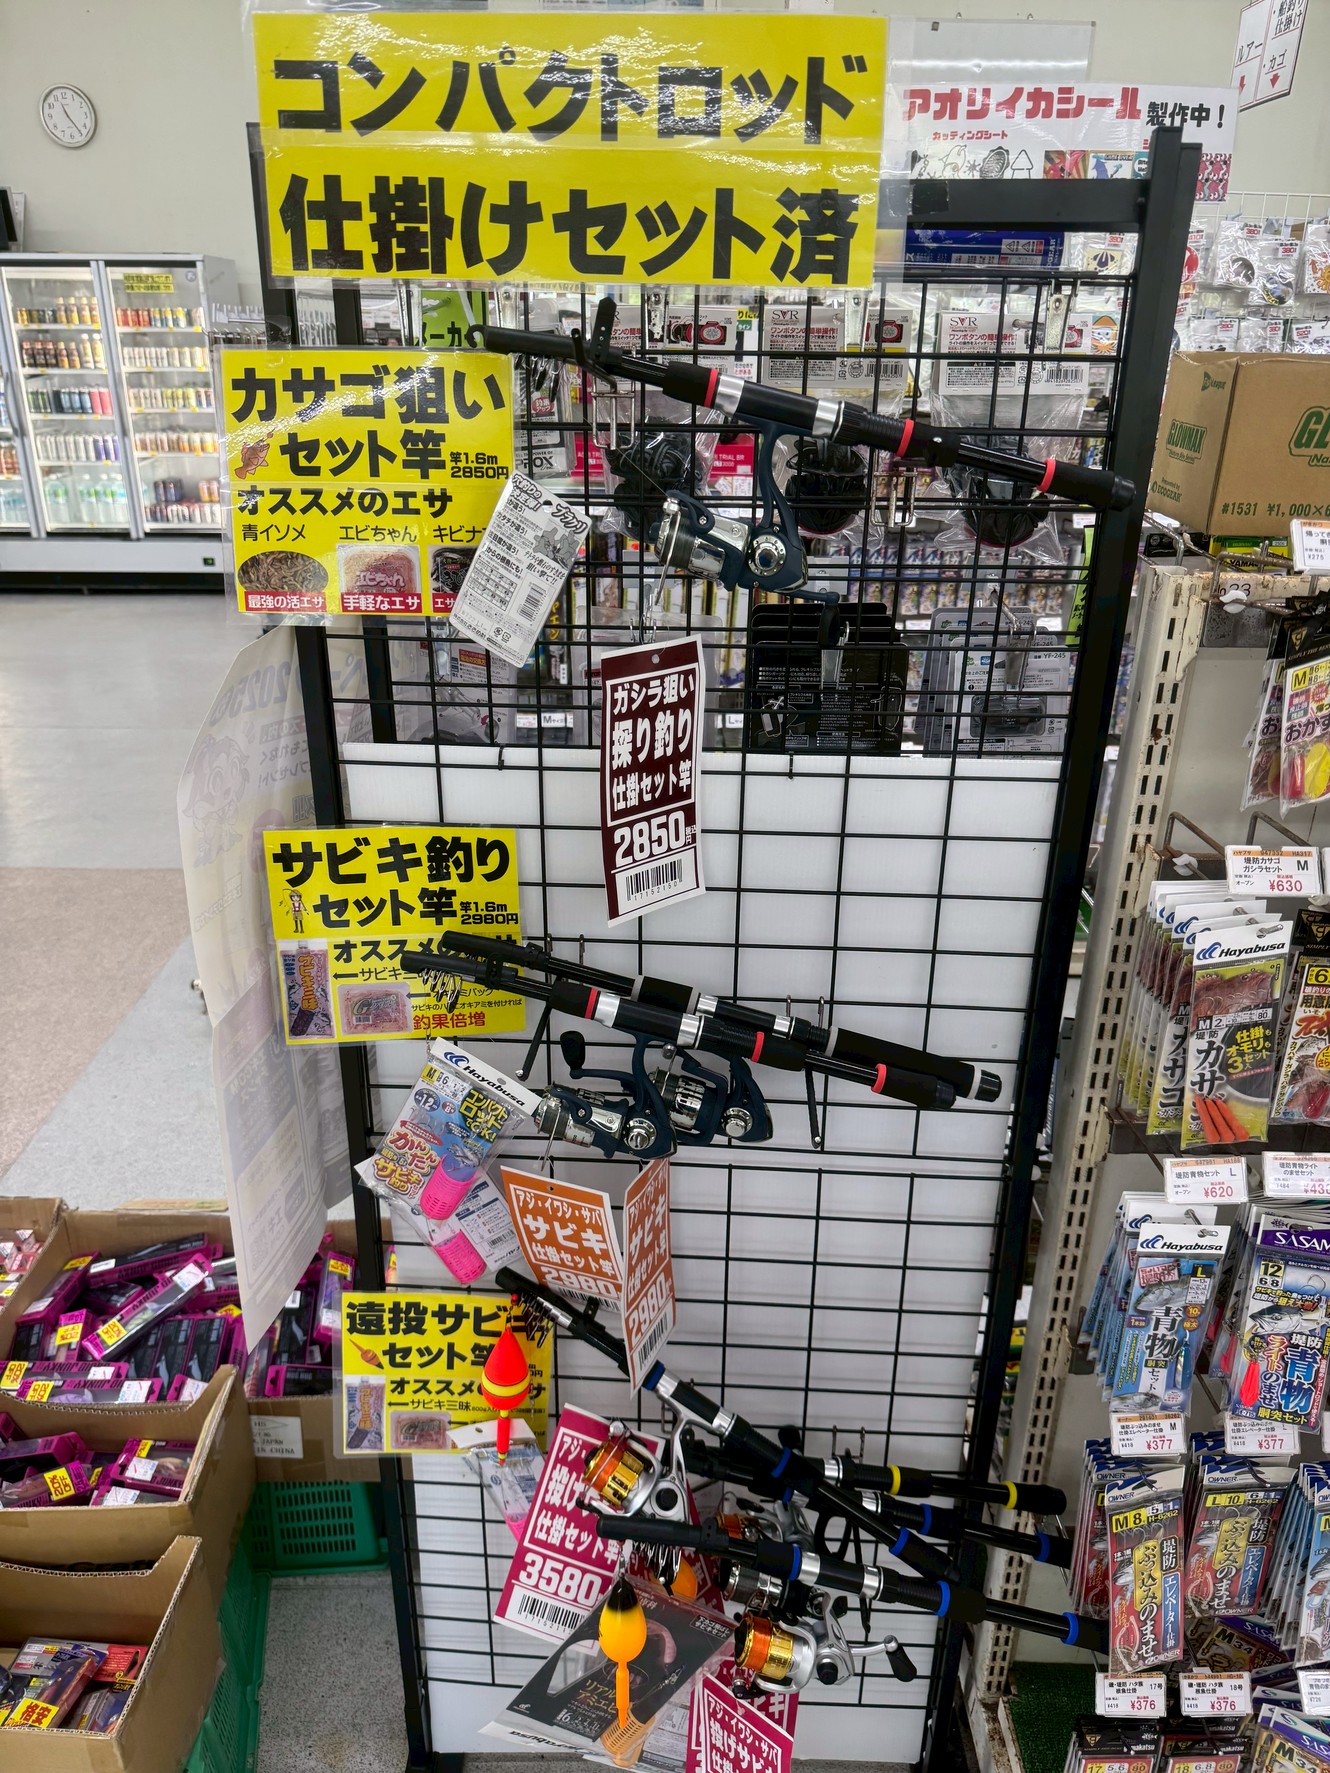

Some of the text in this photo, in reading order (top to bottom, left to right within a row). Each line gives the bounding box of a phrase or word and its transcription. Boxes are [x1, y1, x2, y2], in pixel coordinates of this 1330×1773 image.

[1236, 41, 1263, 62] ルアー
[1268, 49, 1287, 71] カゴ
[274, 46, 869, 145] コンパクトロッド
[902, 86, 1142, 121] アオリイカシール
[932, 130, 1008, 141] カッティングシート
[279, 173, 860, 285] 仕掛けセット済
[771, 310, 799, 320] SVR
[950, 317, 977, 326] SVR
[231, 365, 506, 425] カサゴ狙い
[1168, 422, 1206, 454] GLOWMAX
[280, 429, 447, 480] セット竿
[450, 452, 498, 466] 竿1.6m
[450, 466, 510, 480] 2850円
[237, 485, 453, 517] オススメのエサ
[1157, 484, 1181, 503] ECOGEAR
[1221, 501, 1258, 516] #1531
[242, 523, 307, 543] 青イソメ
[339, 524, 418, 543] エビちゃん
[248, 594, 324, 609] 最強の活エサ
[343, 594, 421, 610] 手軽なエサ
[1043, 652, 1066, 660] YF-245
[1293, 672, 1308, 689] M
[613, 672, 695, 716] ガシラ狙い
[612, 707, 692, 771] 探り釣り
[612, 760, 692, 812] 仕掛セット竿
[615, 810, 685, 868] 2850
[272, 836, 510, 888] サビキ釣り
[1243, 865, 1283, 873] ガシラセット
[1244, 857, 1281, 865] 堤防カサゴ
[1296, 859, 1309, 872] M
[1269, 879, 1303, 893] ¥630
[312, 887, 458, 929] セット竿
[459, 901, 508, 913] 竿1.6m
[460, 913, 519, 926] 2980円
[1218, 942, 1286, 958] Hayabusa
[1313, 968, 1328, 983] 6
[413, 1012, 486, 1031] 釣果倍増
[1198, 1018, 1210, 1030] M
[1195, 1030, 1219, 1040] 堤防
[1227, 1056, 1244, 1074] 3
[1243, 1049, 1271, 1063] セット
[462, 1064, 526, 1108] Hayabusa
[374, 1158, 424, 1185] サビキ
[1175, 1170, 1220, 1180] 堤防青物セット
[1229, 1167, 1237, 1177] L
[1203, 1185, 1234, 1198] ¥620
[516, 1189, 602, 1226] アジ・イワシ・サバ
[523, 1213, 608, 1256] サビキ
[630, 1193, 666, 1266] サビキ
[1161, 1241, 1223, 1252] Hayabusa
[531, 1242, 616, 1277] 仕掛セット竿
[628, 1232, 666, 1299] 仕掛セット竿
[1197, 1266, 1206, 1278] L
[1261, 1262, 1283, 1278] 12
[540, 1266, 617, 1298] 2980
[1260, 1278, 1280, 1288] 6 8
[628, 1272, 667, 1345] 2980
[1144, 1306, 1183, 1359] 青物
[1291, 1333, 1322, 1348] 堤防
[1279, 1347, 1322, 1415] 青物
[410, 1399, 472, 1412] サビキ三昧
[1257, 1407, 1308, 1425] 胴突セット
[1169, 1422, 1177, 1431] M
[1145, 1439, 1173, 1450] ¥377
[1257, 1439, 1284, 1450] ¥377
[50, 1473, 72, 1497] 20% OFF
[1096, 1472, 1126, 1481] OWNER
[1107, 1491, 1135, 1503] OWNER
[1211, 1495, 1221, 1506] L
[1227, 1494, 1240, 1505] 10
[1114, 1517, 1129, 1530] M
[1132, 1512, 1142, 1525] 8
[1151, 1505, 1159, 1514] 5
[1250, 1518, 1269, 1543] 堤防
[1162, 1540, 1177, 1571] 堤防
[1209, 1520, 1249, 1609] ぶっ込みのませ
[518, 1552, 603, 1608] 3580
[1137, 1545, 1159, 1659] ぶっ込みのませ
[1164, 1576, 1177, 1648] エレベーター仕掛
[1215, 1627, 1232, 1642] M
[21, 1701, 52, 1726] 格安
[1130, 1699, 1156, 1711] ¥376
[1210, 1700, 1237, 1711] ¥376
[708, 1696, 778, 1766] アジ・イワシ・サバ
[1274, 1743, 1293, 1760] M
